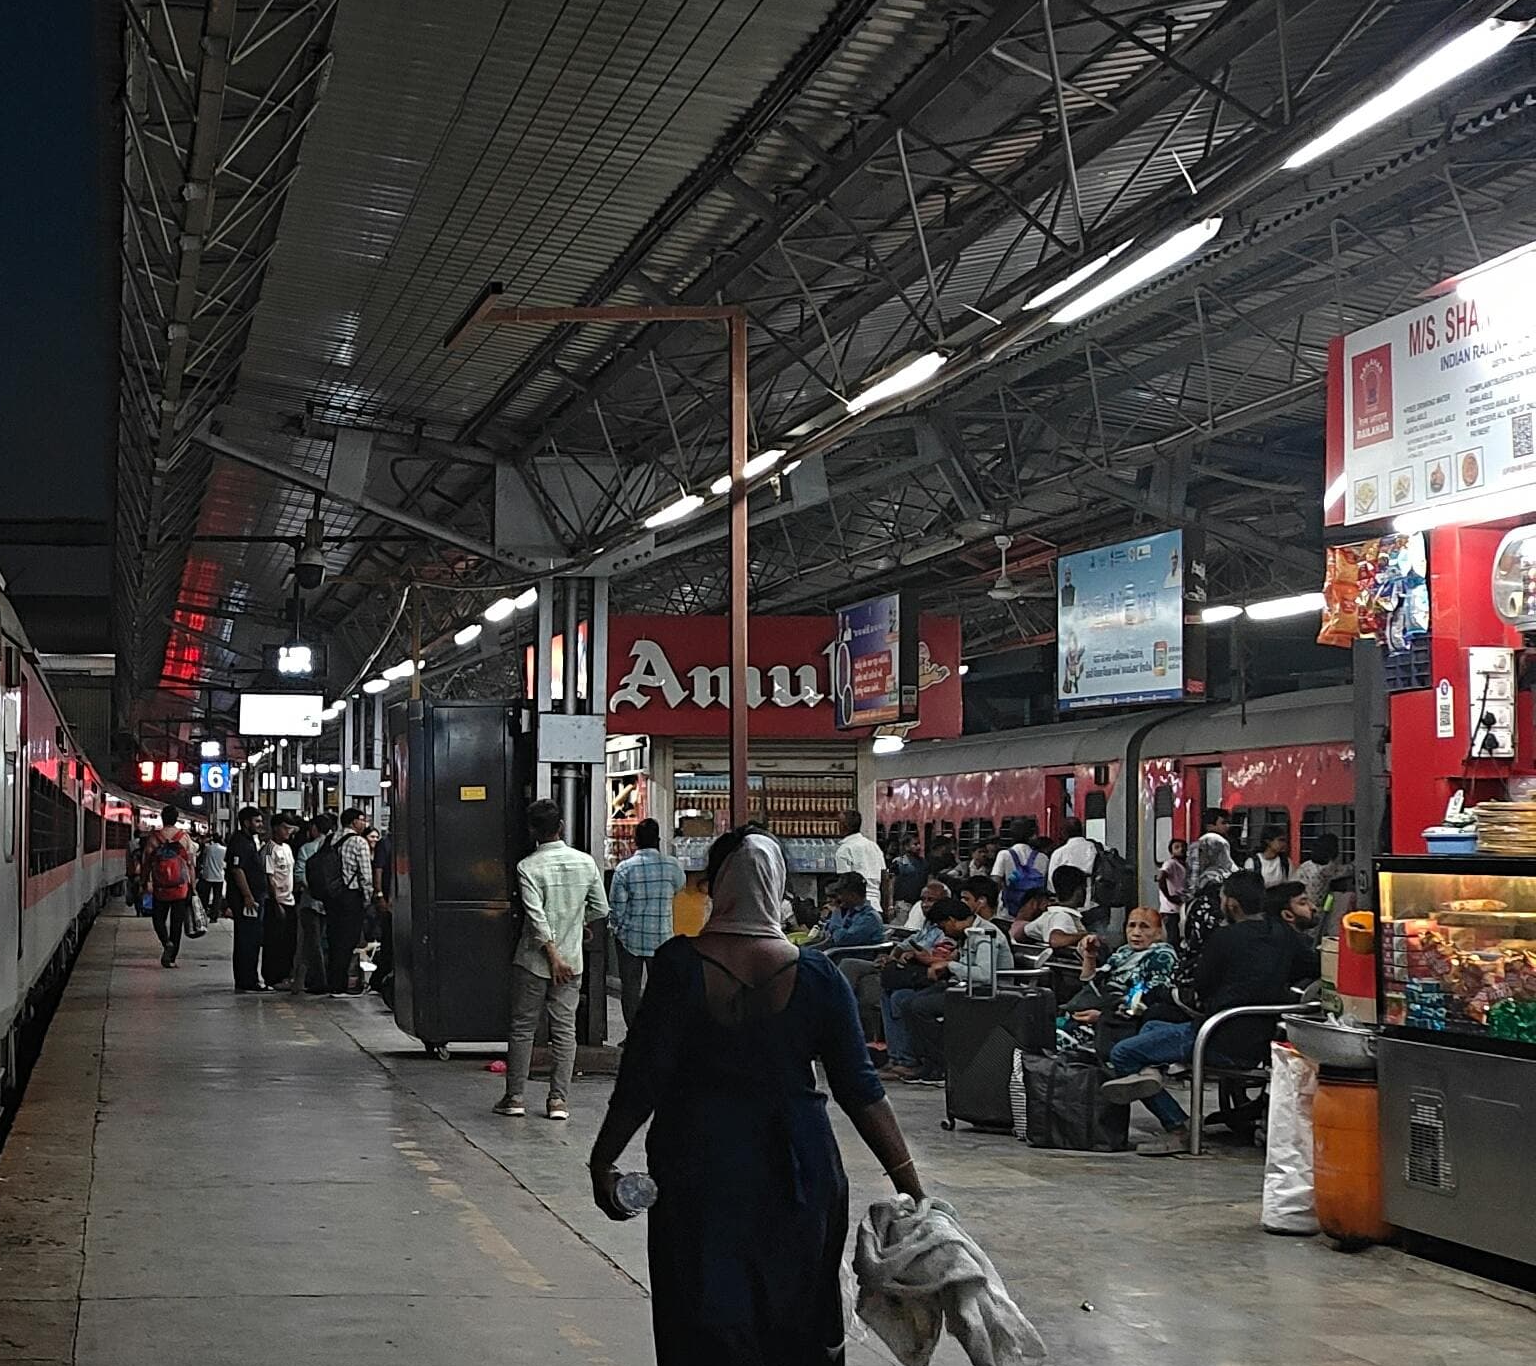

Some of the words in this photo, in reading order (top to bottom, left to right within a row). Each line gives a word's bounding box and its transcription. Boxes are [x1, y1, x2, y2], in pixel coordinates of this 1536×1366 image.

[1408, 314, 1441, 358] M/S.
[1445, 298, 1484, 344] SHA
[1439, 345, 1471, 372] INDIAN
[207, 767, 224, 788] 6
